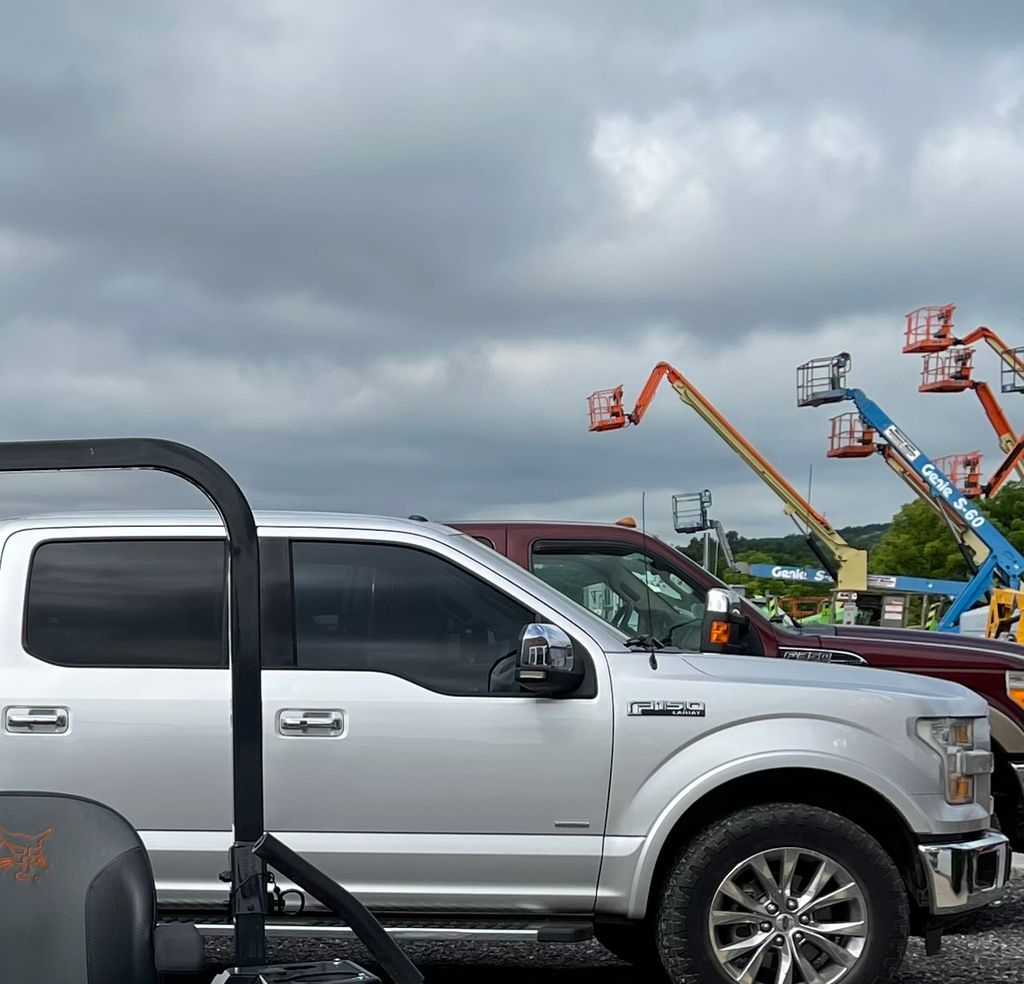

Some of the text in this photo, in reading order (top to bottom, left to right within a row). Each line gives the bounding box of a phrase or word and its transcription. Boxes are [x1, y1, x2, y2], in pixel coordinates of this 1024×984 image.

[921, 463, 986, 528] Genie S-60
[771, 565, 808, 580] Genie
